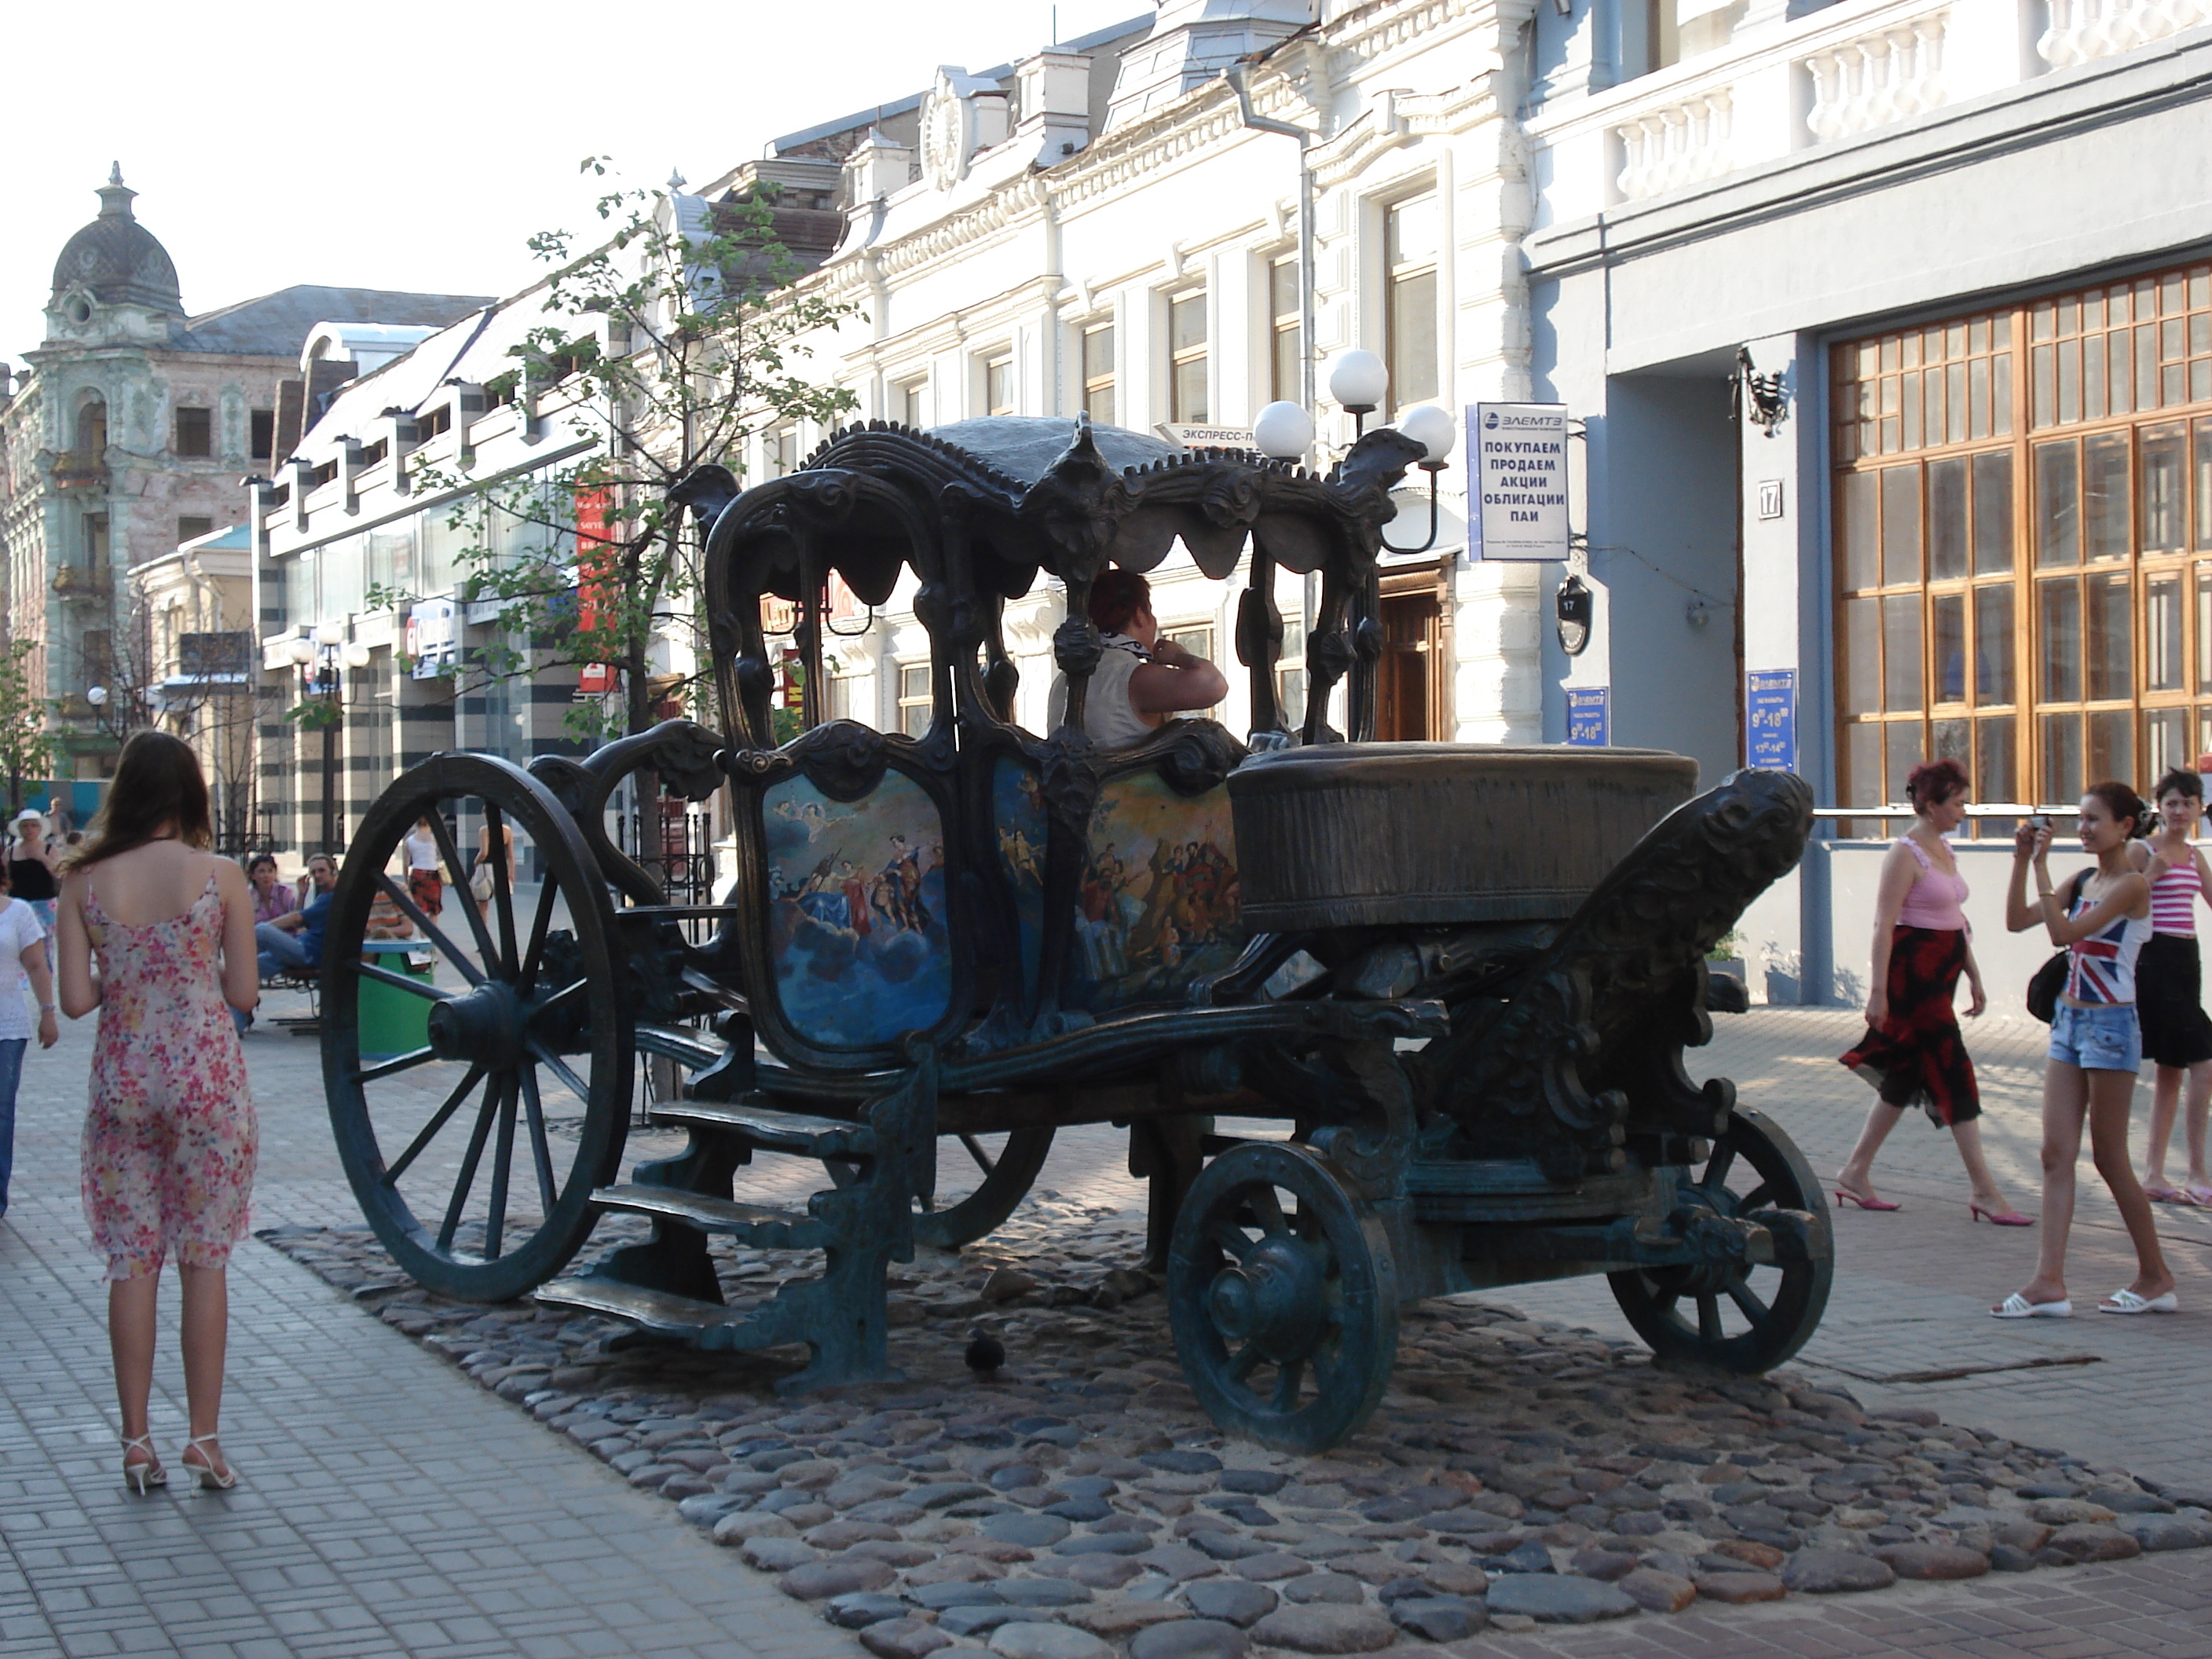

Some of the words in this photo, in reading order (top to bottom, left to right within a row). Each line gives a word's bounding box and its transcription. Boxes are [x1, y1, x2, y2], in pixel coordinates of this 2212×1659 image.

[1502, 416, 1563, 427] ЭЛЕМТЭ
[1485, 441, 1561, 454] ПОКУПАЕМ
[1490, 459, 1556, 472] ПРОДАЕМ
[1500, 476, 1547, 489] АКЦИИ
[1484, 493, 1565, 507] ОБЛИГАЦИИ
[1761, 486, 1777, 514] 17
[1510, 511, 1539, 522] ПАИ
[1563, 601, 1575, 611] 17
